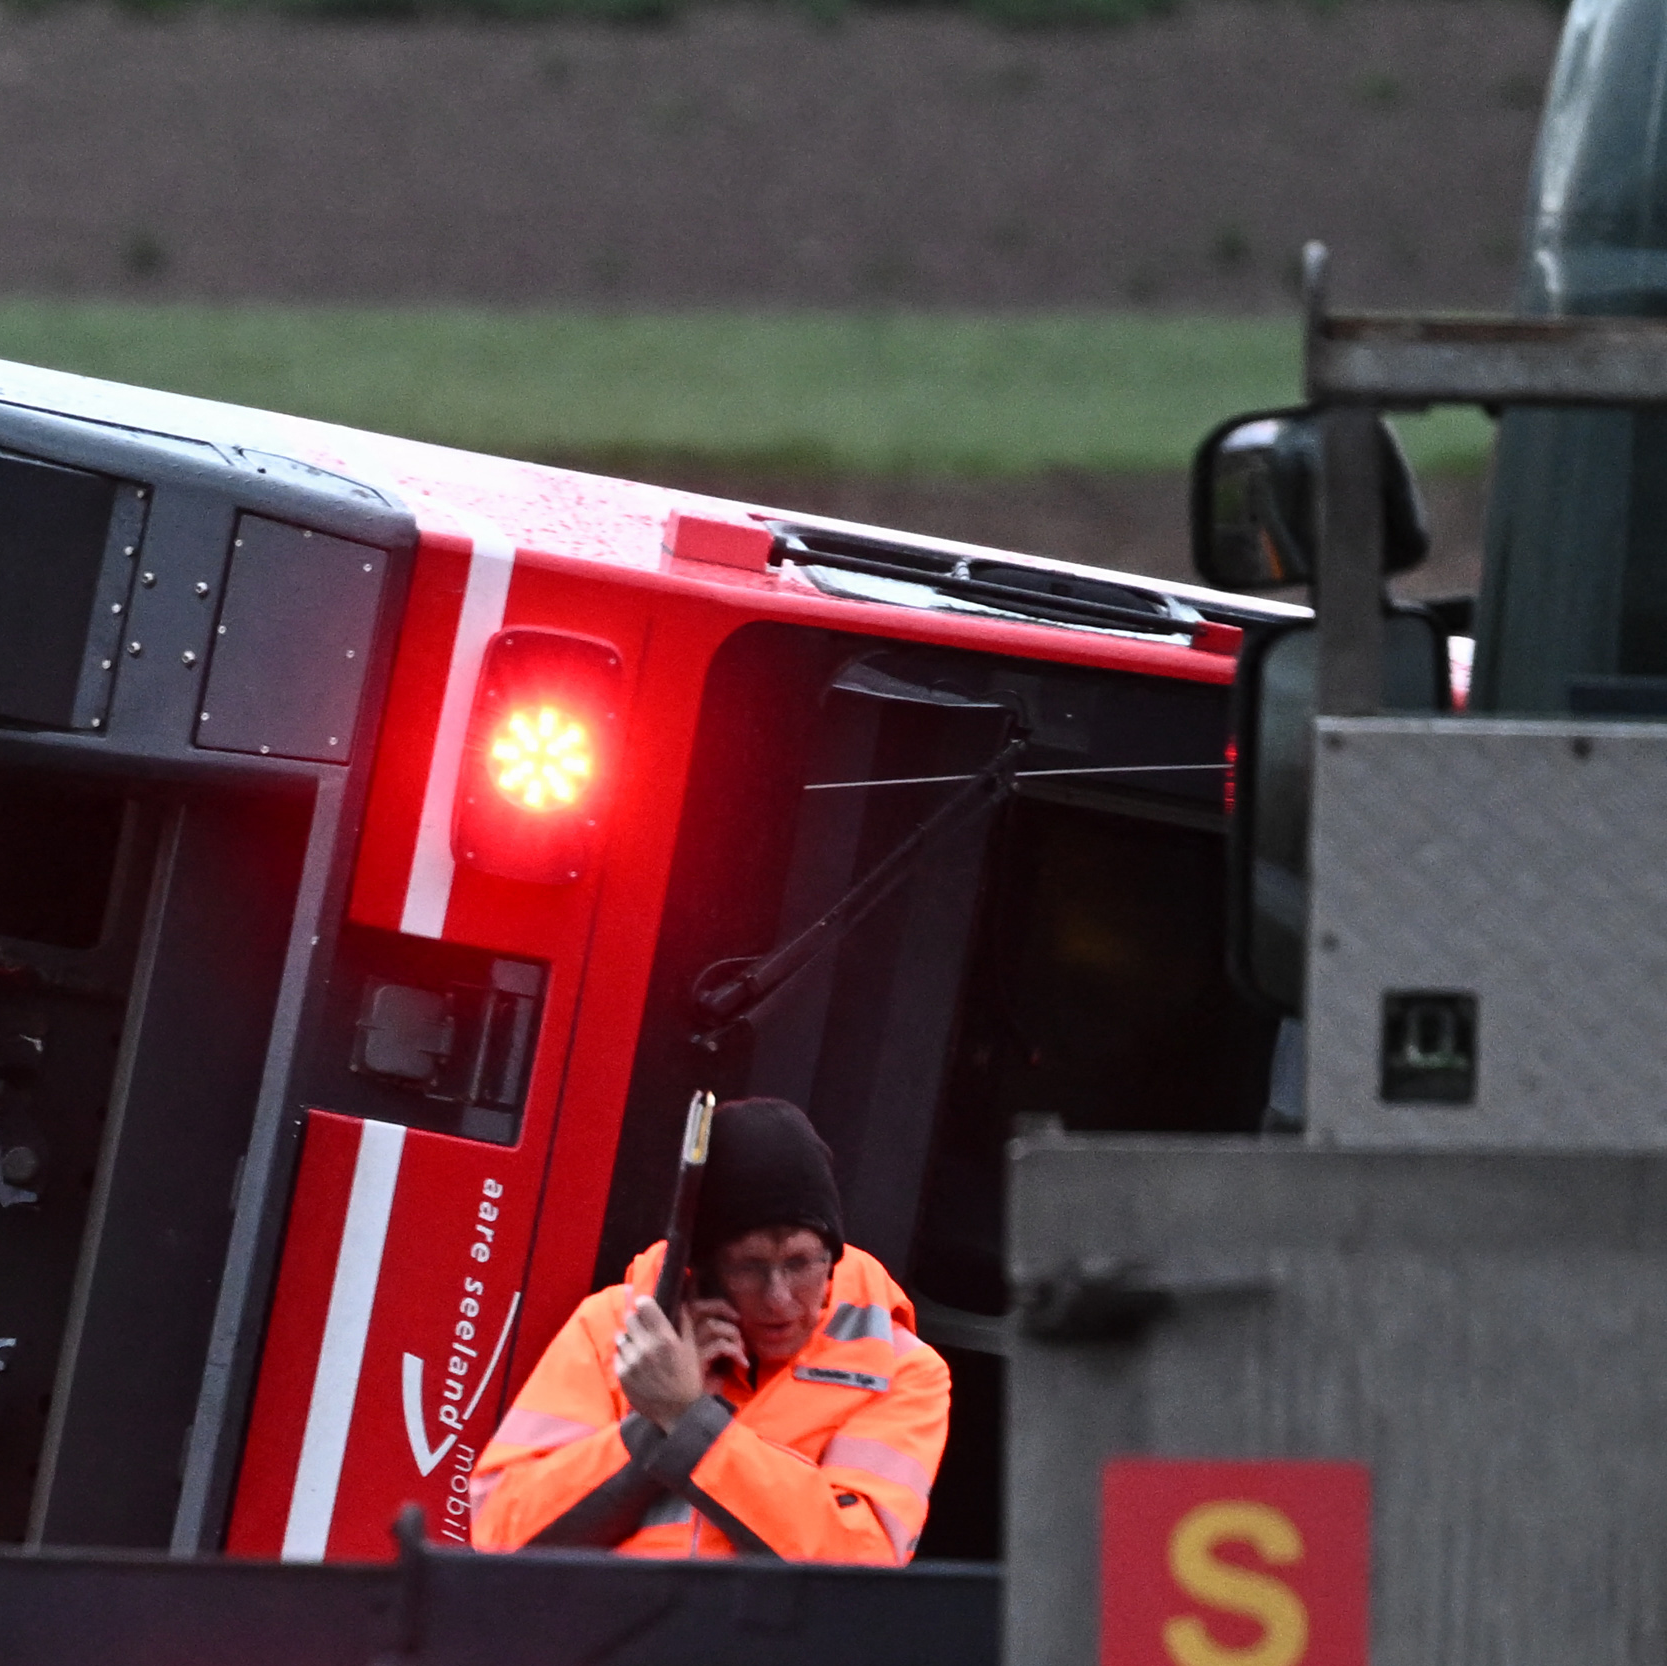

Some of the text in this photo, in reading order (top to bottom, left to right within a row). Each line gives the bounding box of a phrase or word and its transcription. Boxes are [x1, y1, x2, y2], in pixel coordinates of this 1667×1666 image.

[438, 1178, 503, 1543] aare seeland mobil
